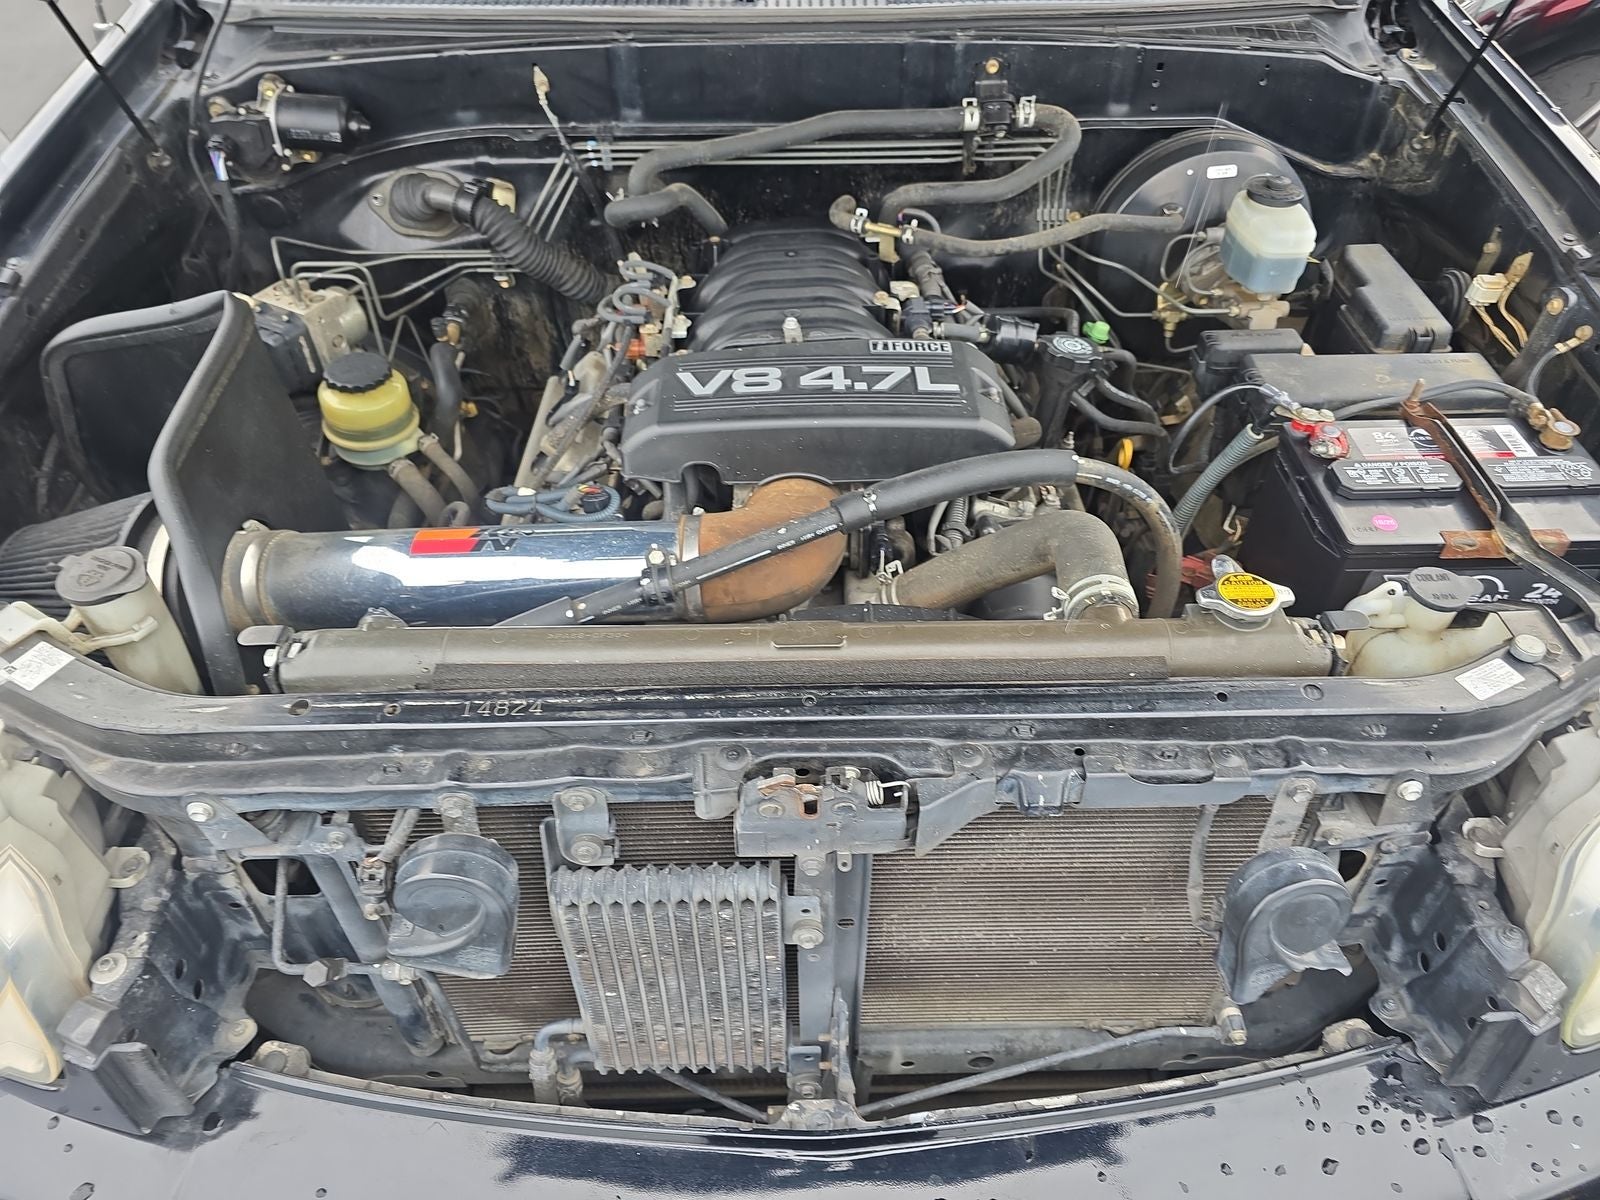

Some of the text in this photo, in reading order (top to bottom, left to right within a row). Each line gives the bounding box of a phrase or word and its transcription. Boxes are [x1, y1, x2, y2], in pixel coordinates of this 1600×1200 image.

[675, 366, 961, 395] V8 4.7L
[1524, 582, 1563, 599] 24
[461, 700, 544, 717] 14824
